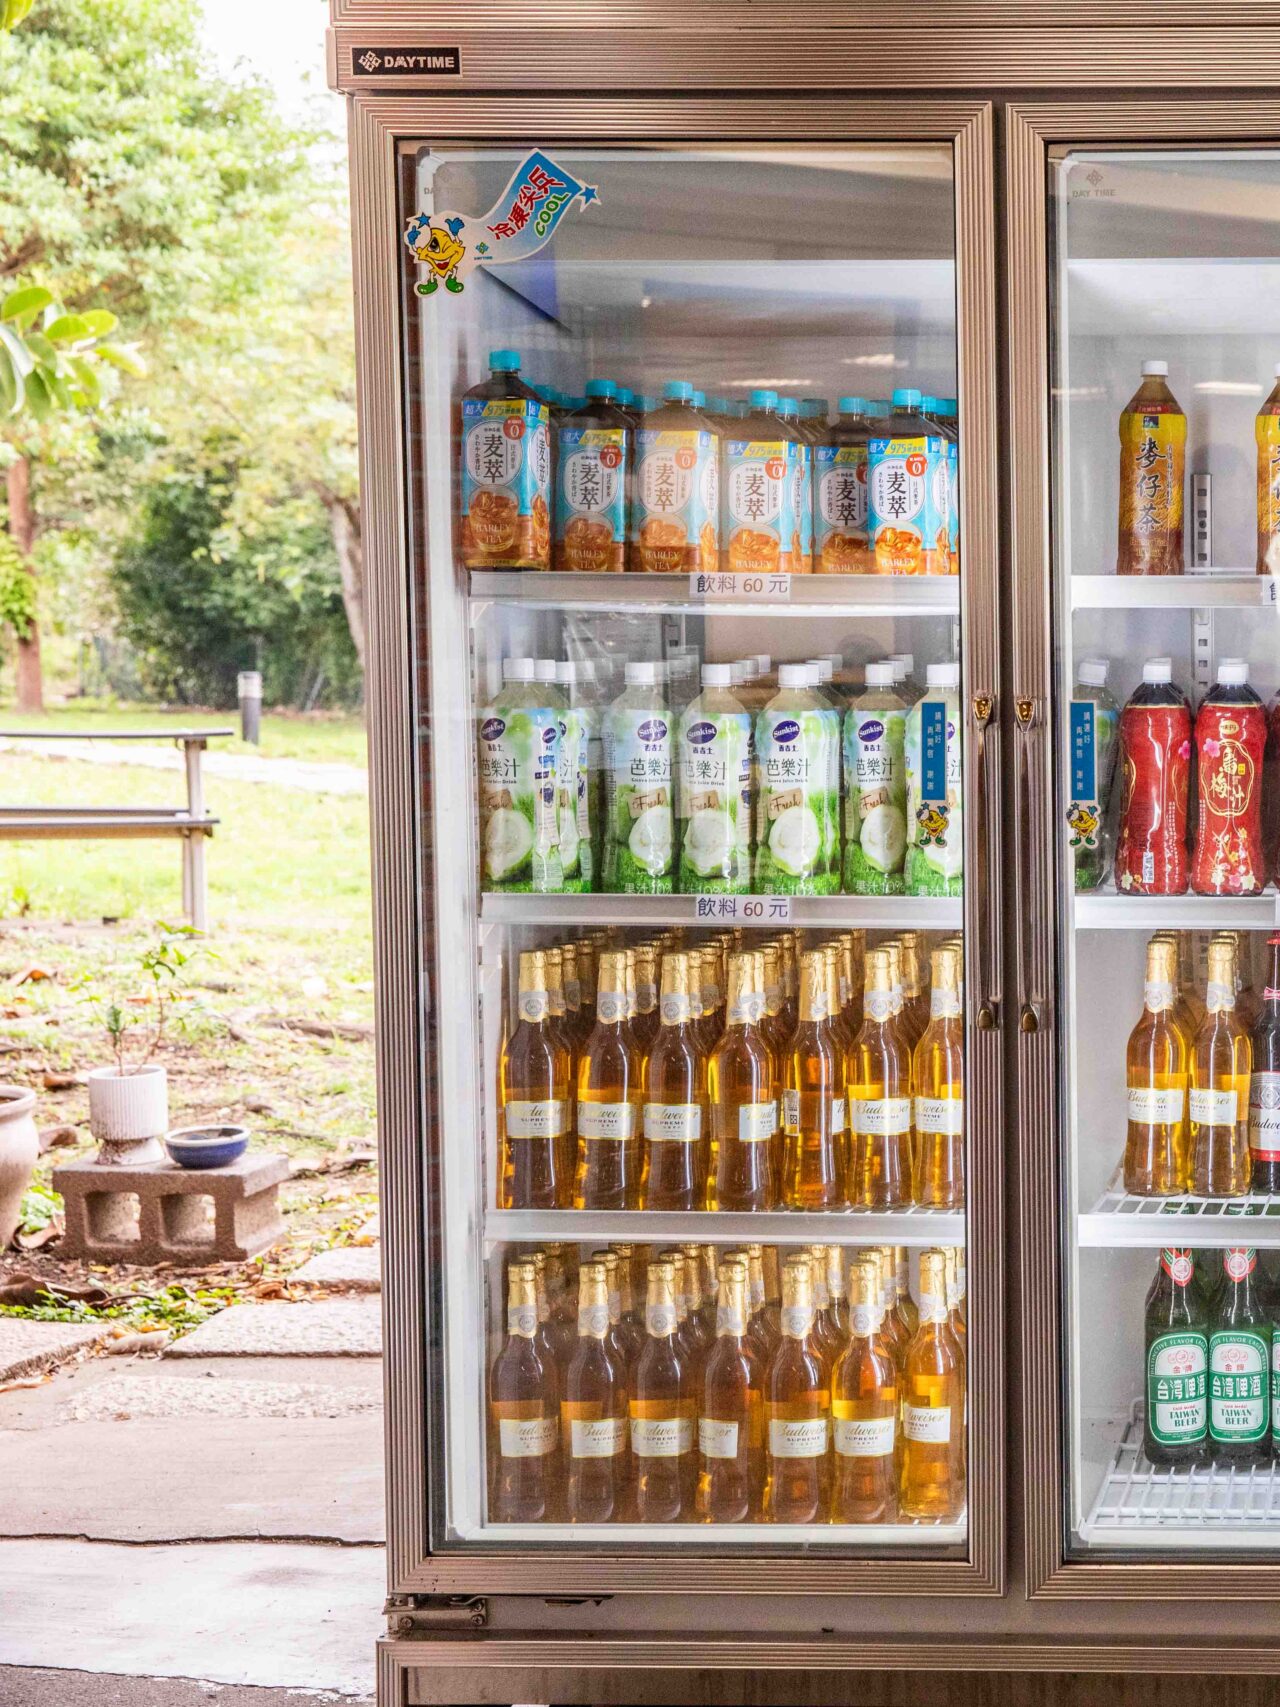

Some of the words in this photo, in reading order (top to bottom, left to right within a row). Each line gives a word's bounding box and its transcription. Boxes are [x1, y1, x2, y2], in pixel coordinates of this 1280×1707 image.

[384, 56, 454, 68] DAYTIME
[534, 191, 570, 238] COOL
[890, 443, 906, 454] 975
[1135, 436, 1166, 532] 麥仔茶
[475, 523, 511, 534] BARLEY
[571, 549, 605, 560] BARLEY
[645, 551, 679, 561] BARLEY
[580, 559, 596, 569] TEA
[653, 561, 670, 571] TEA
[736, 560, 772, 569] BARLEY
[828, 563, 864, 572] BARLEY
[881, 558, 915, 567] BARLEY
[696, 575, 736, 594] 飲料
[743, 578, 763, 593] 60
[769, 575, 788, 593] 元
[687, 725, 717, 742] Sunkist
[772, 721, 800, 739] Sunkist
[859, 725, 884, 738] Sunkist
[766, 758, 810, 777] 芭樂汁
[856, 758, 896, 777] 芭樂汁
[773, 795, 801, 811] Fresh
[862, 795, 887, 811] Fresh
[698, 898, 737, 916] 飲料
[743, 902, 763, 917] 60
[769, 899, 788, 917] 元
[1169, 1408, 1200, 1419] TAIWAN
[1221, 1408, 1252, 1418] TAIWAN
[1175, 1418, 1198, 1427] BEER
[1225, 1417, 1249, 1426] BEER
